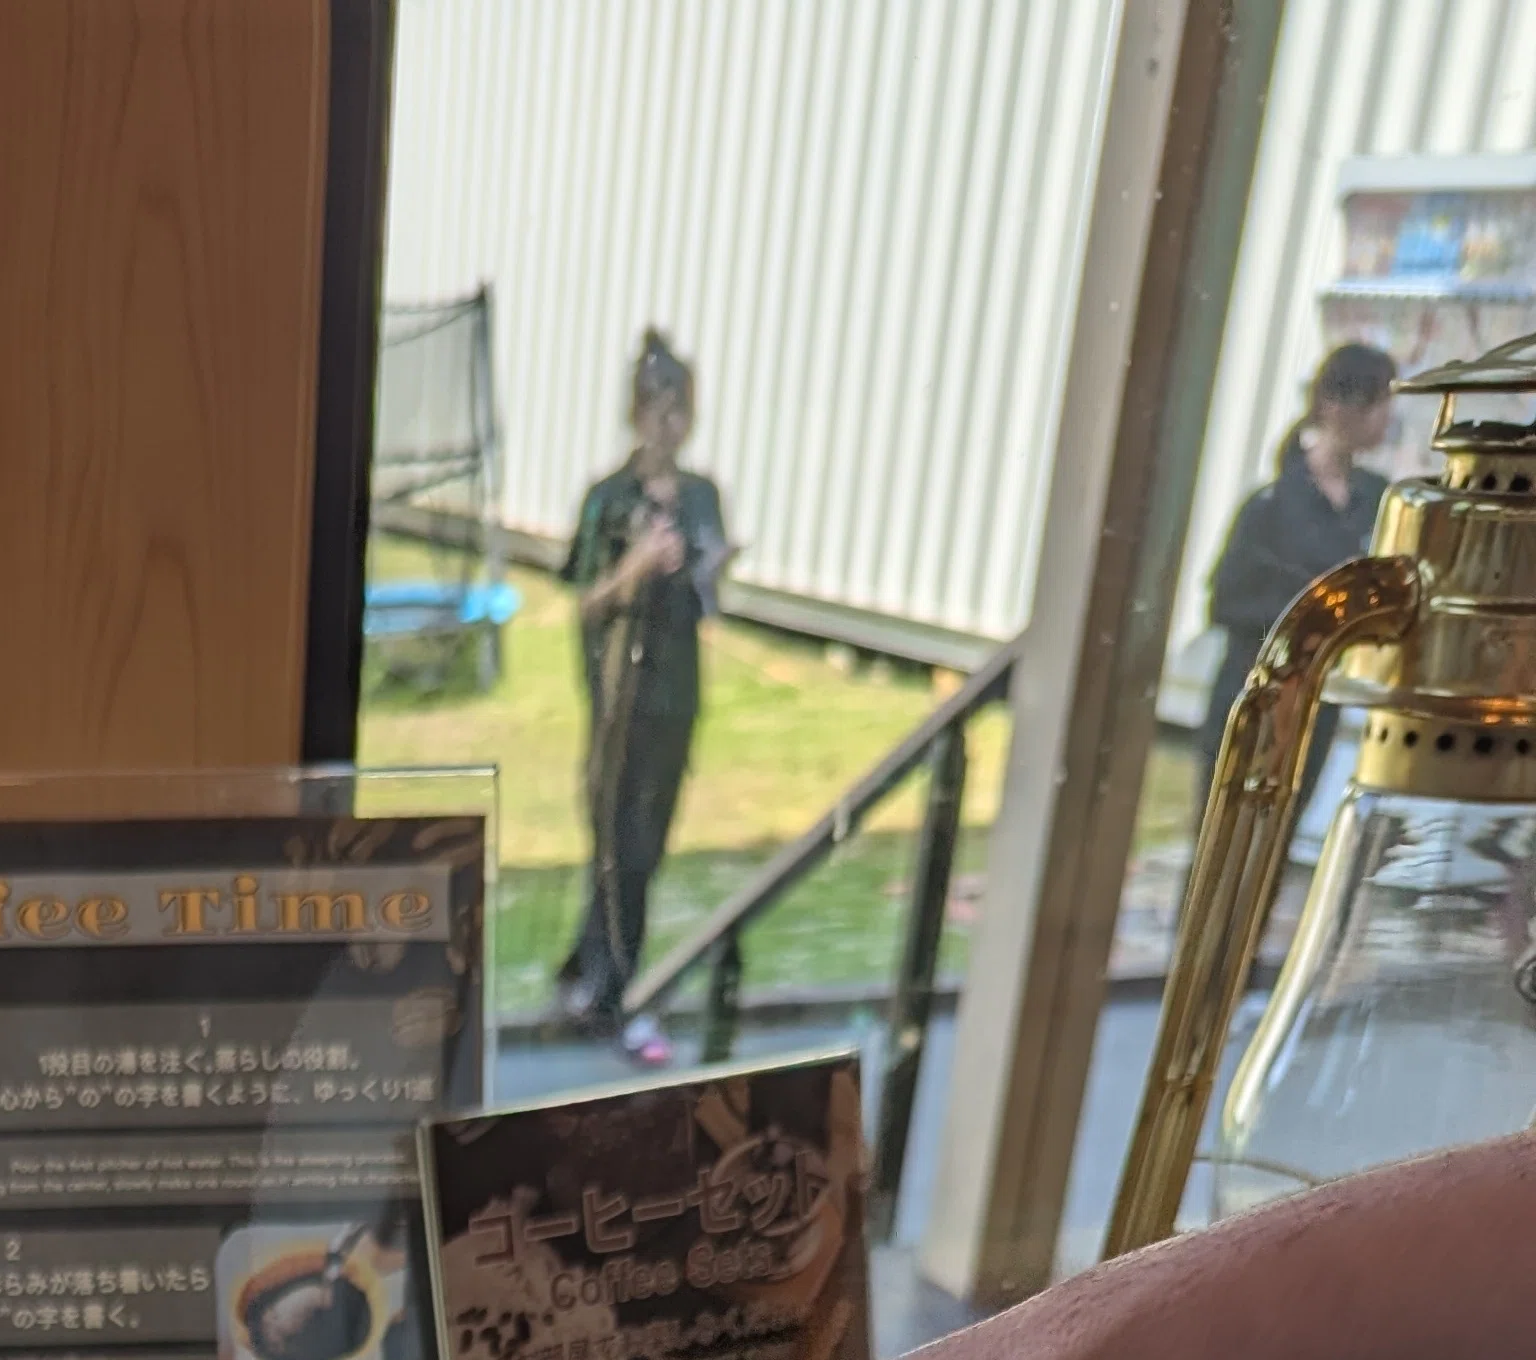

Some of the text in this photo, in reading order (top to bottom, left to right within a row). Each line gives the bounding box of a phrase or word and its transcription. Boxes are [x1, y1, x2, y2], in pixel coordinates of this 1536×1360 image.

[160, 874, 434, 939] Time
[198, 1014, 212, 1039] 1
[468, 1150, 830, 1268] コーヒーセット
[4, 1239, 21, 1261] 2
[550, 1254, 682, 1312] Coffee
